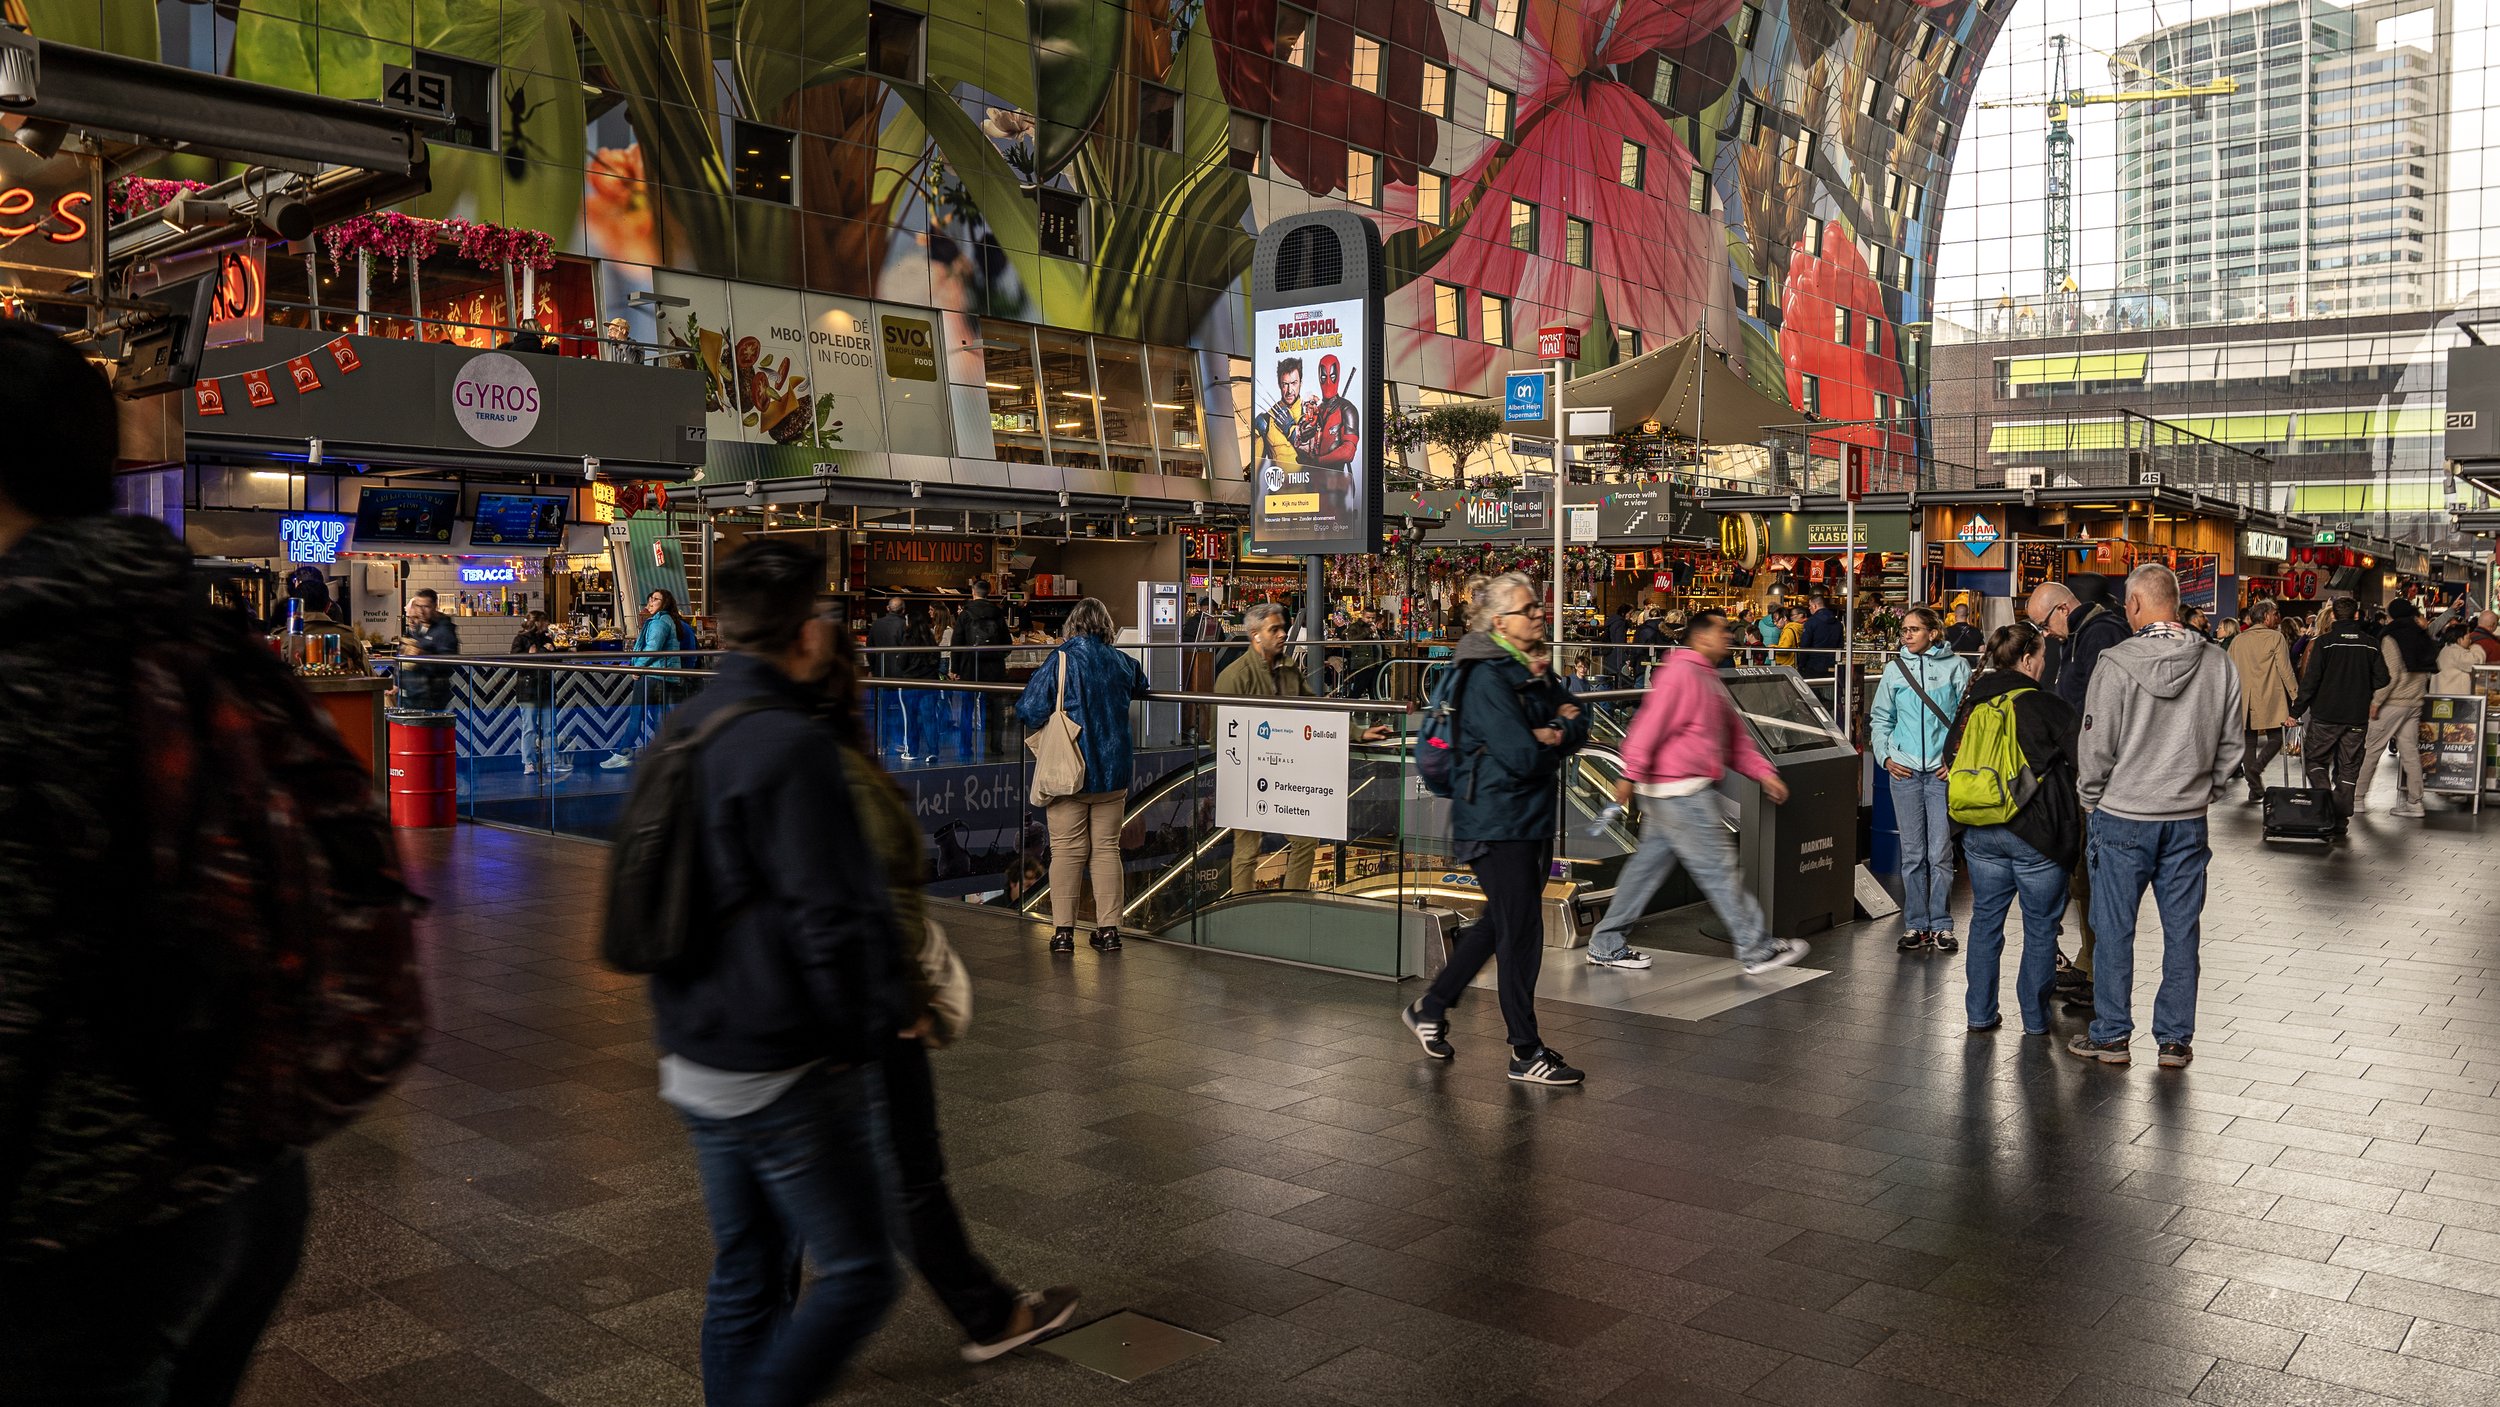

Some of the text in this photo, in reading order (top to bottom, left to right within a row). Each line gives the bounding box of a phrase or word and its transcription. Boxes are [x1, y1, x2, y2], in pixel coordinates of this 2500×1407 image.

[387, 72, 445, 112] 49
[853, 319, 870, 335] DÉ
[1279, 319, 1339, 339] DEADPOOL
[885, 326, 926, 347] SVO
[1279, 334, 1343, 353] WOLVERINE
[1540, 333, 1562, 342] MARKT
[886, 346, 934, 358] VAKOPLEIDING
[1542, 340, 1560, 355] HAL
[818, 349, 873, 369] IN FOOD!
[914, 358, 934, 366] FOOD
[455, 380, 539, 413] GYROS
[1526, 403, 1541, 411] Heijn
[475, 412, 518, 423] TERRAS UP
[2446, 414, 2474, 428] 20
[687, 427, 706, 439] 77
[1521, 443, 1553, 457] Interparking
[826, 464, 839, 474] 74
[1288, 472, 1310, 484] THUIS
[2141, 474, 2159, 483] 46
[1615, 490, 1658, 499] Terrace with
[1696, 488, 1709, 496] 48
[282, 519, 345, 543] PICK UP
[611, 526, 627, 536] 112
[290, 541, 336, 564] HERE
[873, 540, 984, 564] FAMILY NUTS
[461, 568, 514, 582] TERACCE
[1191, 576, 1205, 586] BAR
[1655, 575, 1671, 590] illy
[1274, 781, 1334, 797] Parkeergarage
[917, 779, 955, 817] het
[1274, 804, 1310, 817] Toiletten
[1800, 836, 1834, 855] MARKTHAL
